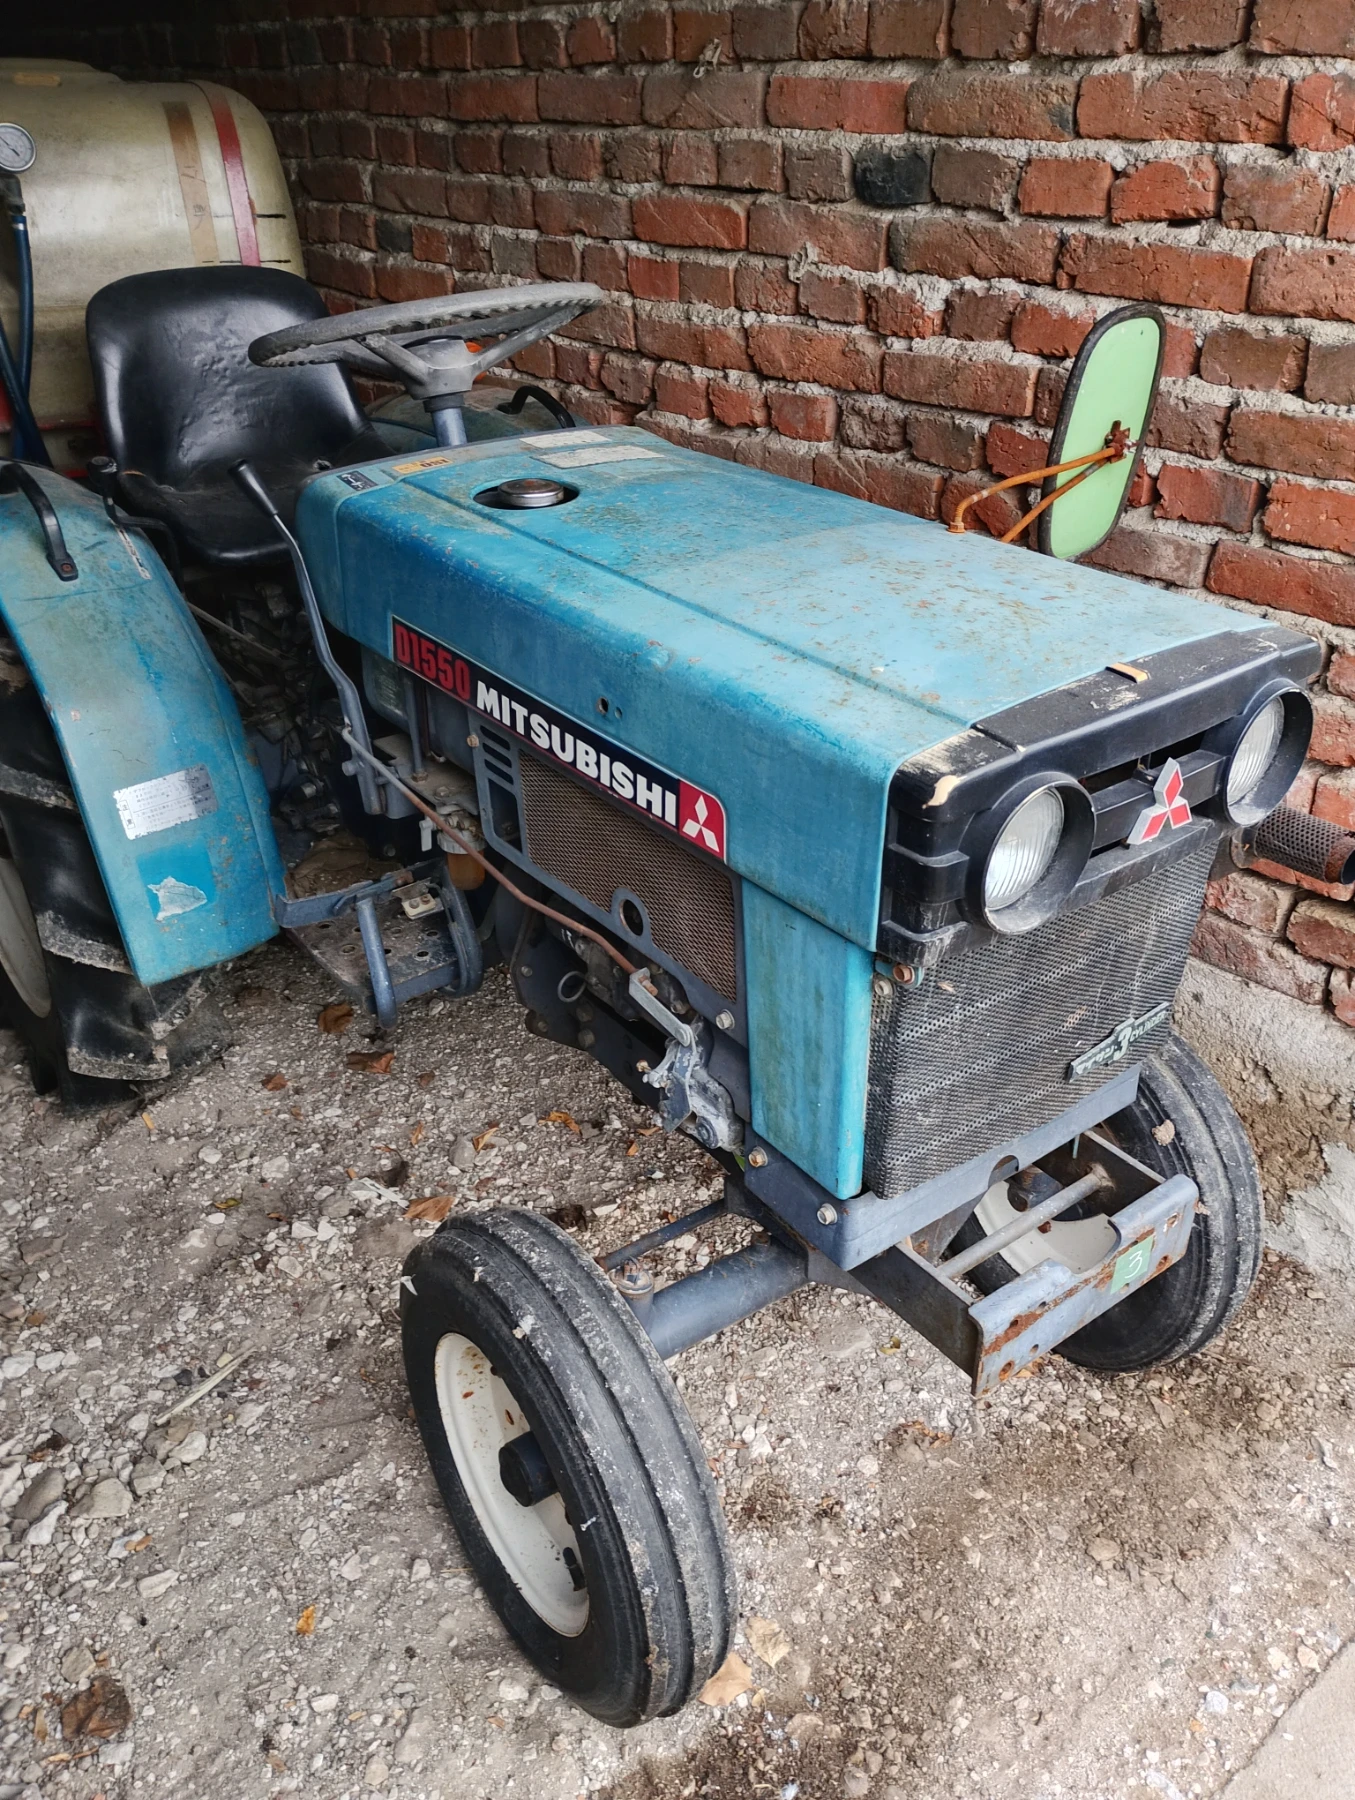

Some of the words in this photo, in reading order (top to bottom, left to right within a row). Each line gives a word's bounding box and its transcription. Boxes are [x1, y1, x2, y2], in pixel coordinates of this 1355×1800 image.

[395, 623, 471, 701] D1550
[476, 680, 677, 827] MITSUBISHI
[1113, 1026, 1132, 1062] 3
[1124, 1250, 1143, 1279] 3
